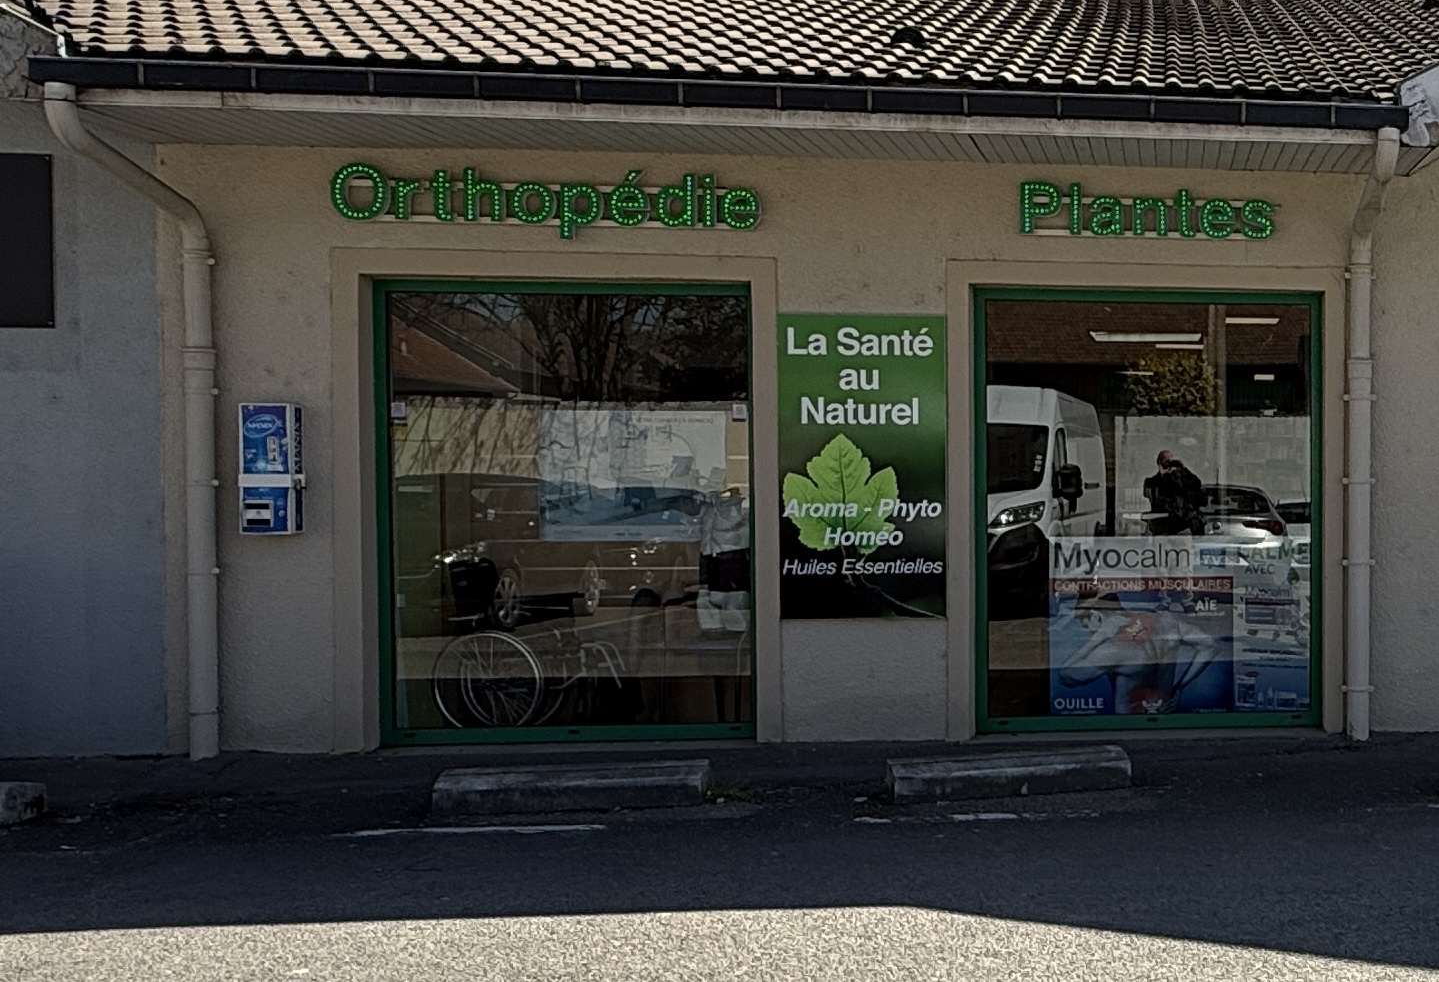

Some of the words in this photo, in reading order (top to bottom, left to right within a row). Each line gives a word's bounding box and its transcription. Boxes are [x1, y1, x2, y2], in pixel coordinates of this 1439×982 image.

[330, 163, 763, 239] Orthopédie
[1020, 181, 1277, 239] Plantes
[786, 326, 828, 356] La
[837, 327, 934, 357] Santé
[839, 368, 880, 391] au
[800, 396, 920, 425] Naturel
[782, 498, 859, 519] Aroma
[878, 499, 942, 522] Phyto
[823, 527, 904, 547] Homéo
[783, 559, 838, 576] Huiles
[842, 559, 943, 576] Essentielles
[1054, 543, 1190, 574] Myocalm
[1245, 564, 1275, 575] AVEC
[1054, 580, 1145, 592] CONTRACTIONS
[1148, 579, 1232, 591] MUSCULAIRES
[1054, 697, 1104, 710] OUILLE
